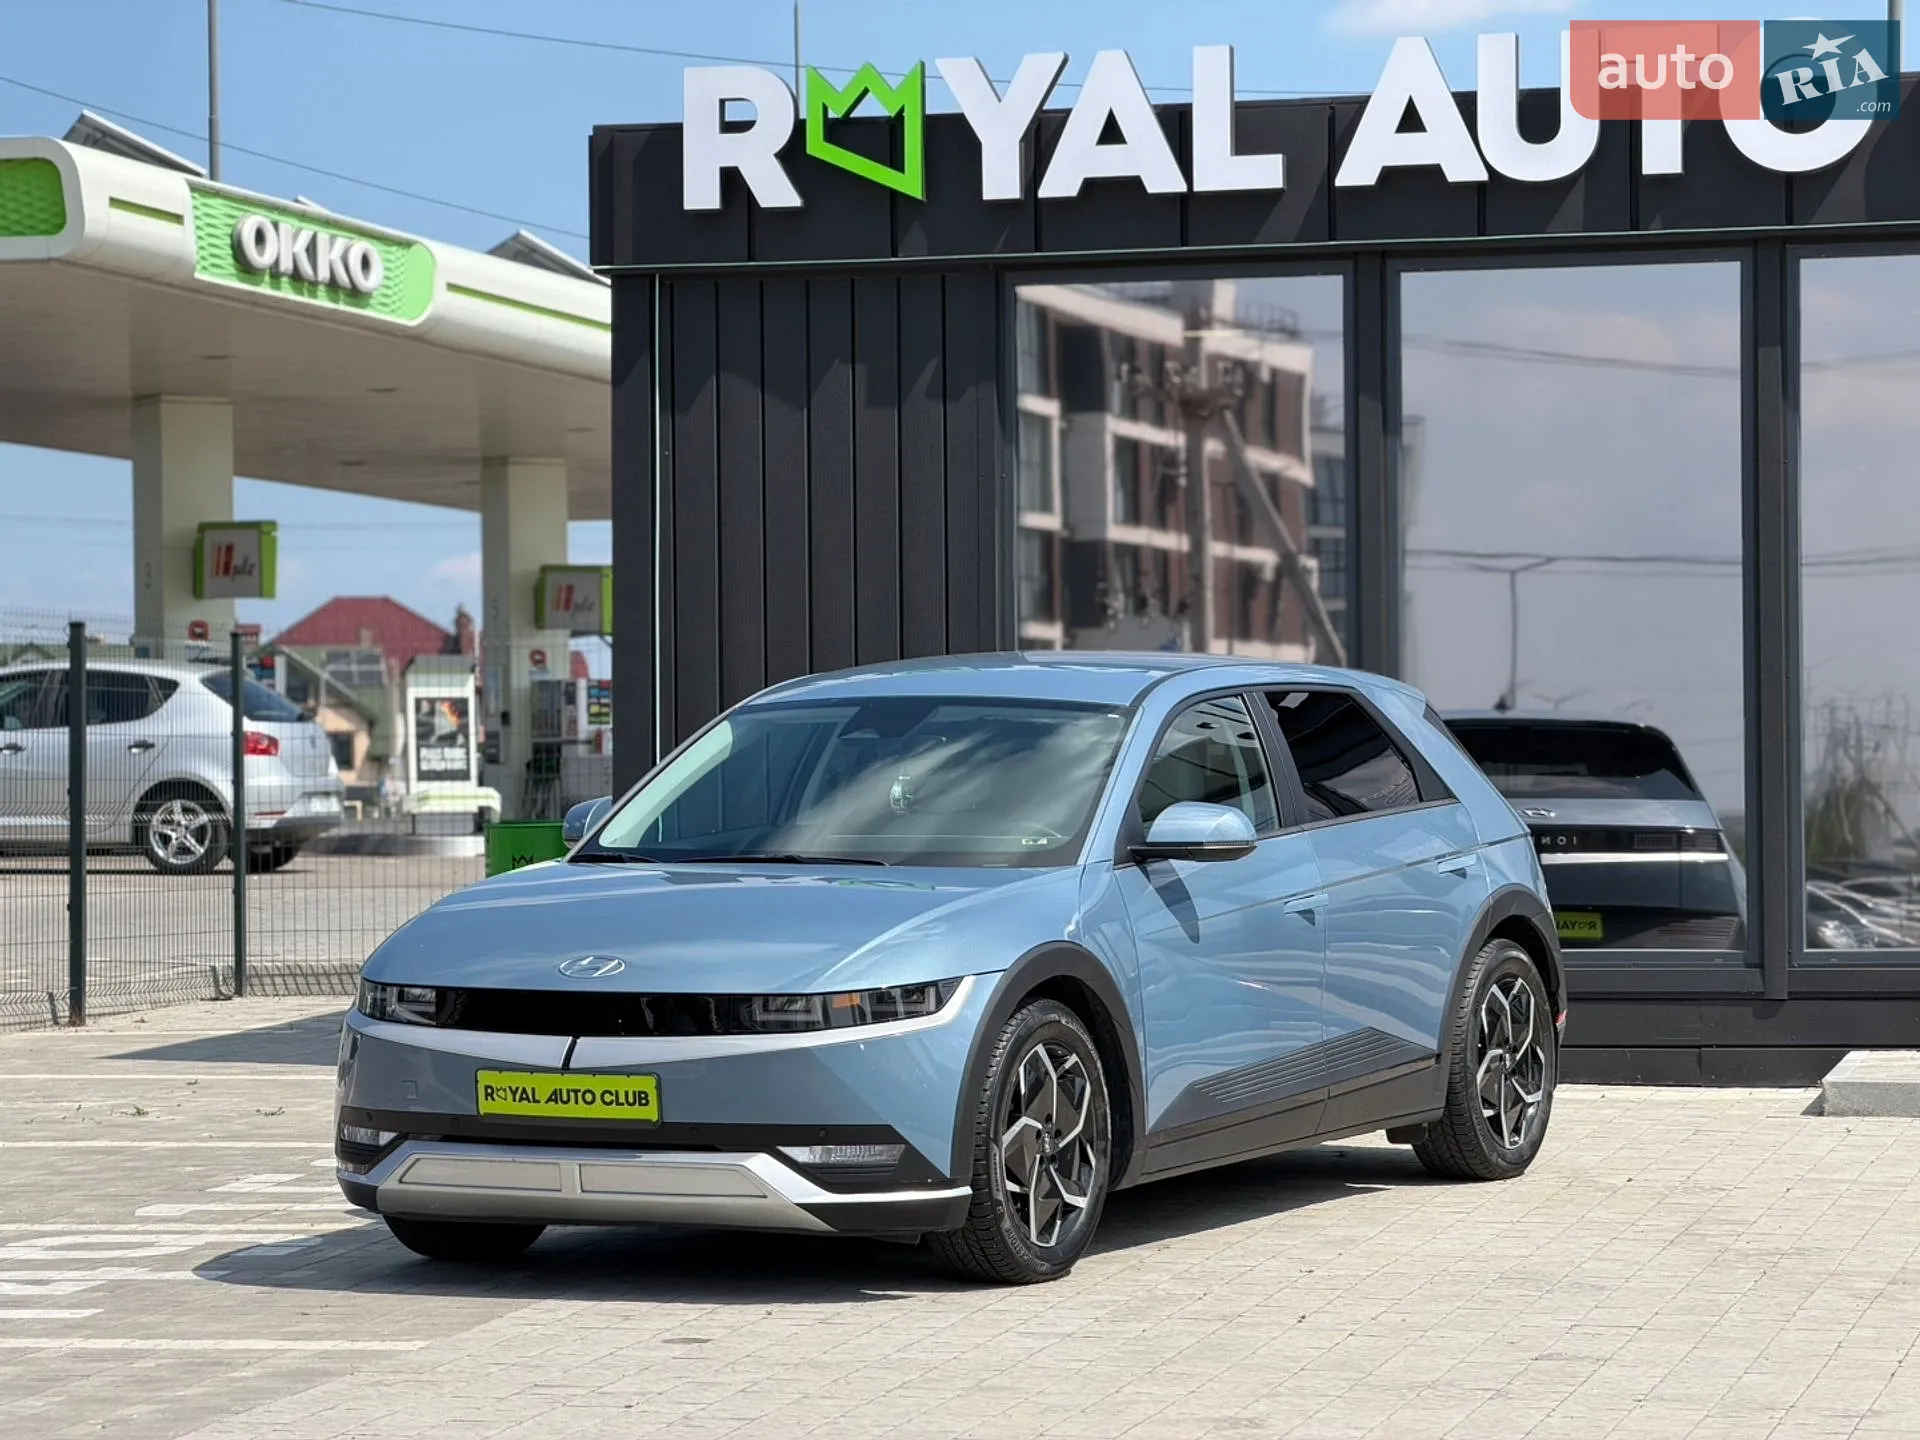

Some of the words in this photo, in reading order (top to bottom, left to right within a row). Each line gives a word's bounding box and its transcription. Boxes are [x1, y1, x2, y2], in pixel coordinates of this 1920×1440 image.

[1334, 17, 1876, 187] AUTO
[235, 214, 384, 293] OKKO
[544, 1087, 597, 1106] AUTO
[600, 1089, 650, 1107] CLUB
